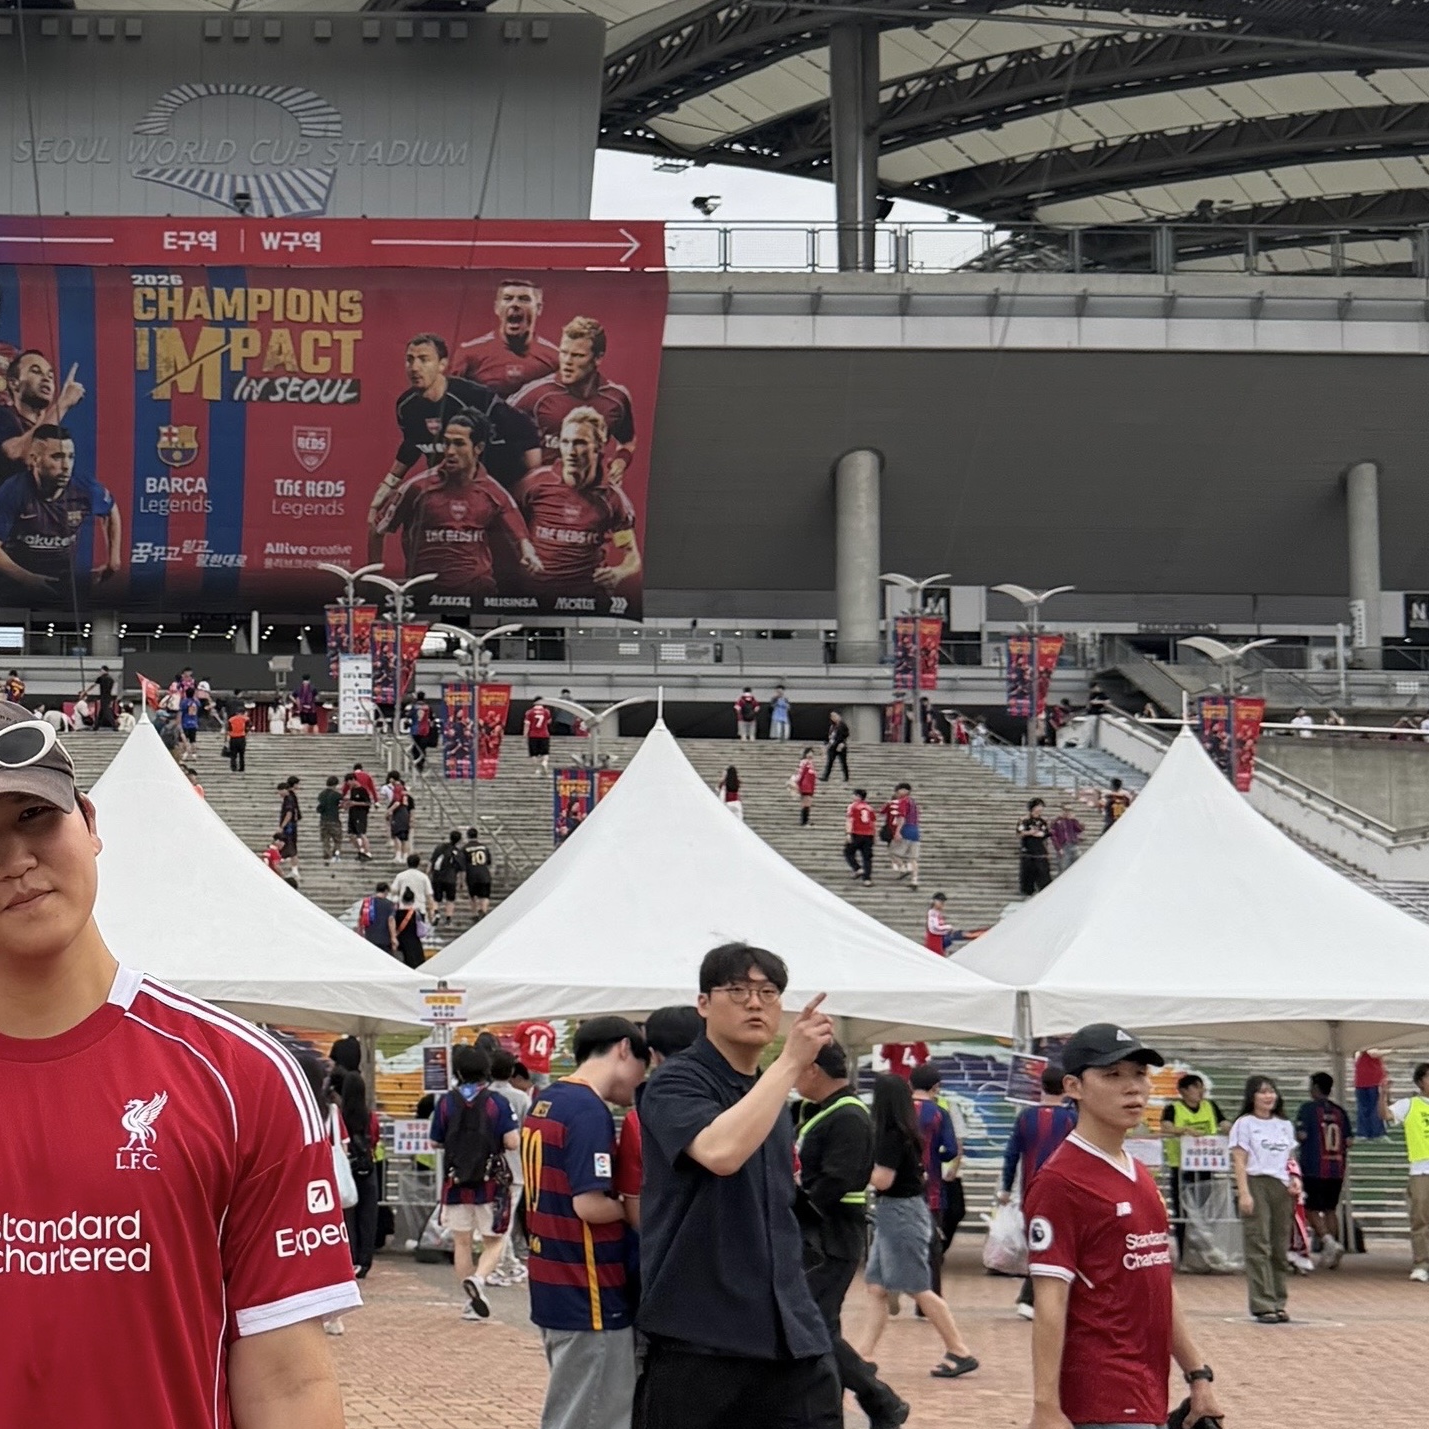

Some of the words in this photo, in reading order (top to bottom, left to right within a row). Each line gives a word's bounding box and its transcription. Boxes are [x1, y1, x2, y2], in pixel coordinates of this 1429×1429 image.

[12, 138, 110, 164] SEOUL
[126, 139, 237, 166] WORLD
[249, 139, 313, 166] CUP
[322, 139, 469, 167] STADIUM
[163, 230, 217, 252] E구역
[260, 230, 321, 252] W구역
[131, 274, 183, 286] 2026
[132, 285, 364, 324] CHAMPIONS
[134, 326, 363, 401] IMPACT
[275, 377, 358, 404] SEOUL
[145, 476, 209, 496] BARÇA
[139, 496, 213, 516] Legends
[272, 499, 345, 519] Legends
[384, 595, 414, 607] SS
[1411, 602, 1429, 620] N
[529, 1033, 548, 1057] 14
[902, 1046, 917, 1068] 4
[522, 1126, 543, 1213] 10
